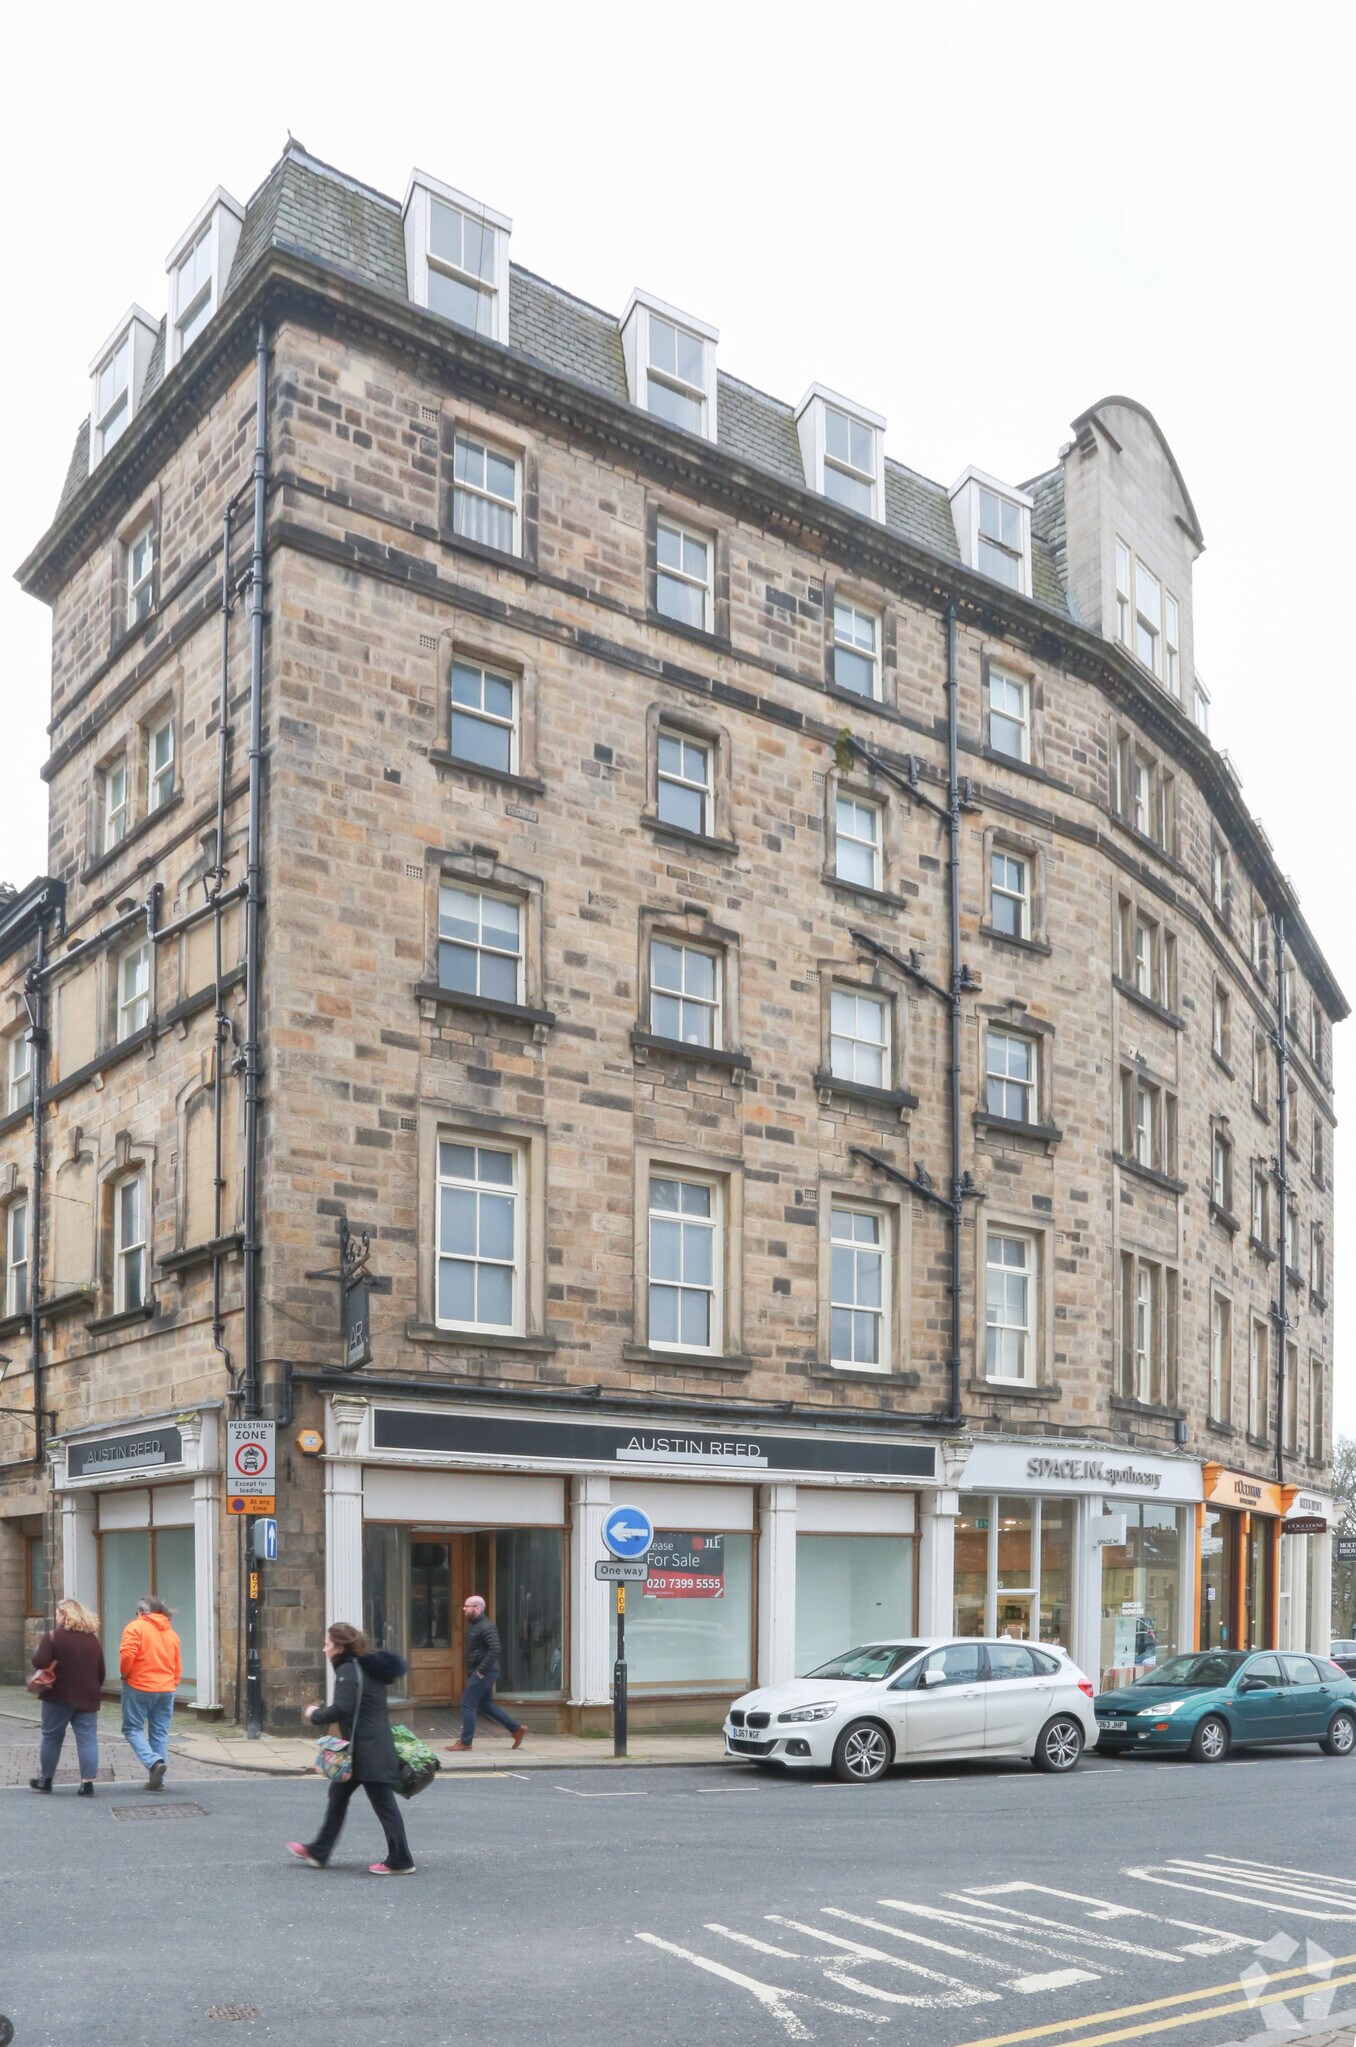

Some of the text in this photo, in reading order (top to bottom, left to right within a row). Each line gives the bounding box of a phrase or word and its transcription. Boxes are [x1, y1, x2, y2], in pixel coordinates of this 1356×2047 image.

[235, 1431, 267, 1440] ZONE
[87, 1439, 161, 1464] AUSTIN REED
[626, 1436, 761, 1458] AUSTIN REED
[234, 1480, 257, 1488] Except
[239, 1487, 263, 1495] loading
[648, 1541, 674, 1551] ease
[704, 1538, 721, 1549] JLL
[647, 1552, 700, 1567] For Sale
[600, 1566, 644, 1577] One way
[646, 1579, 721, 1589] 020 7399 5555
[1097, 1720, 1124, 1729] 363 JHP
[735, 1729, 761, 1739] LD67 WGF
[635, 1881, 1267, 2041] ENTRY
